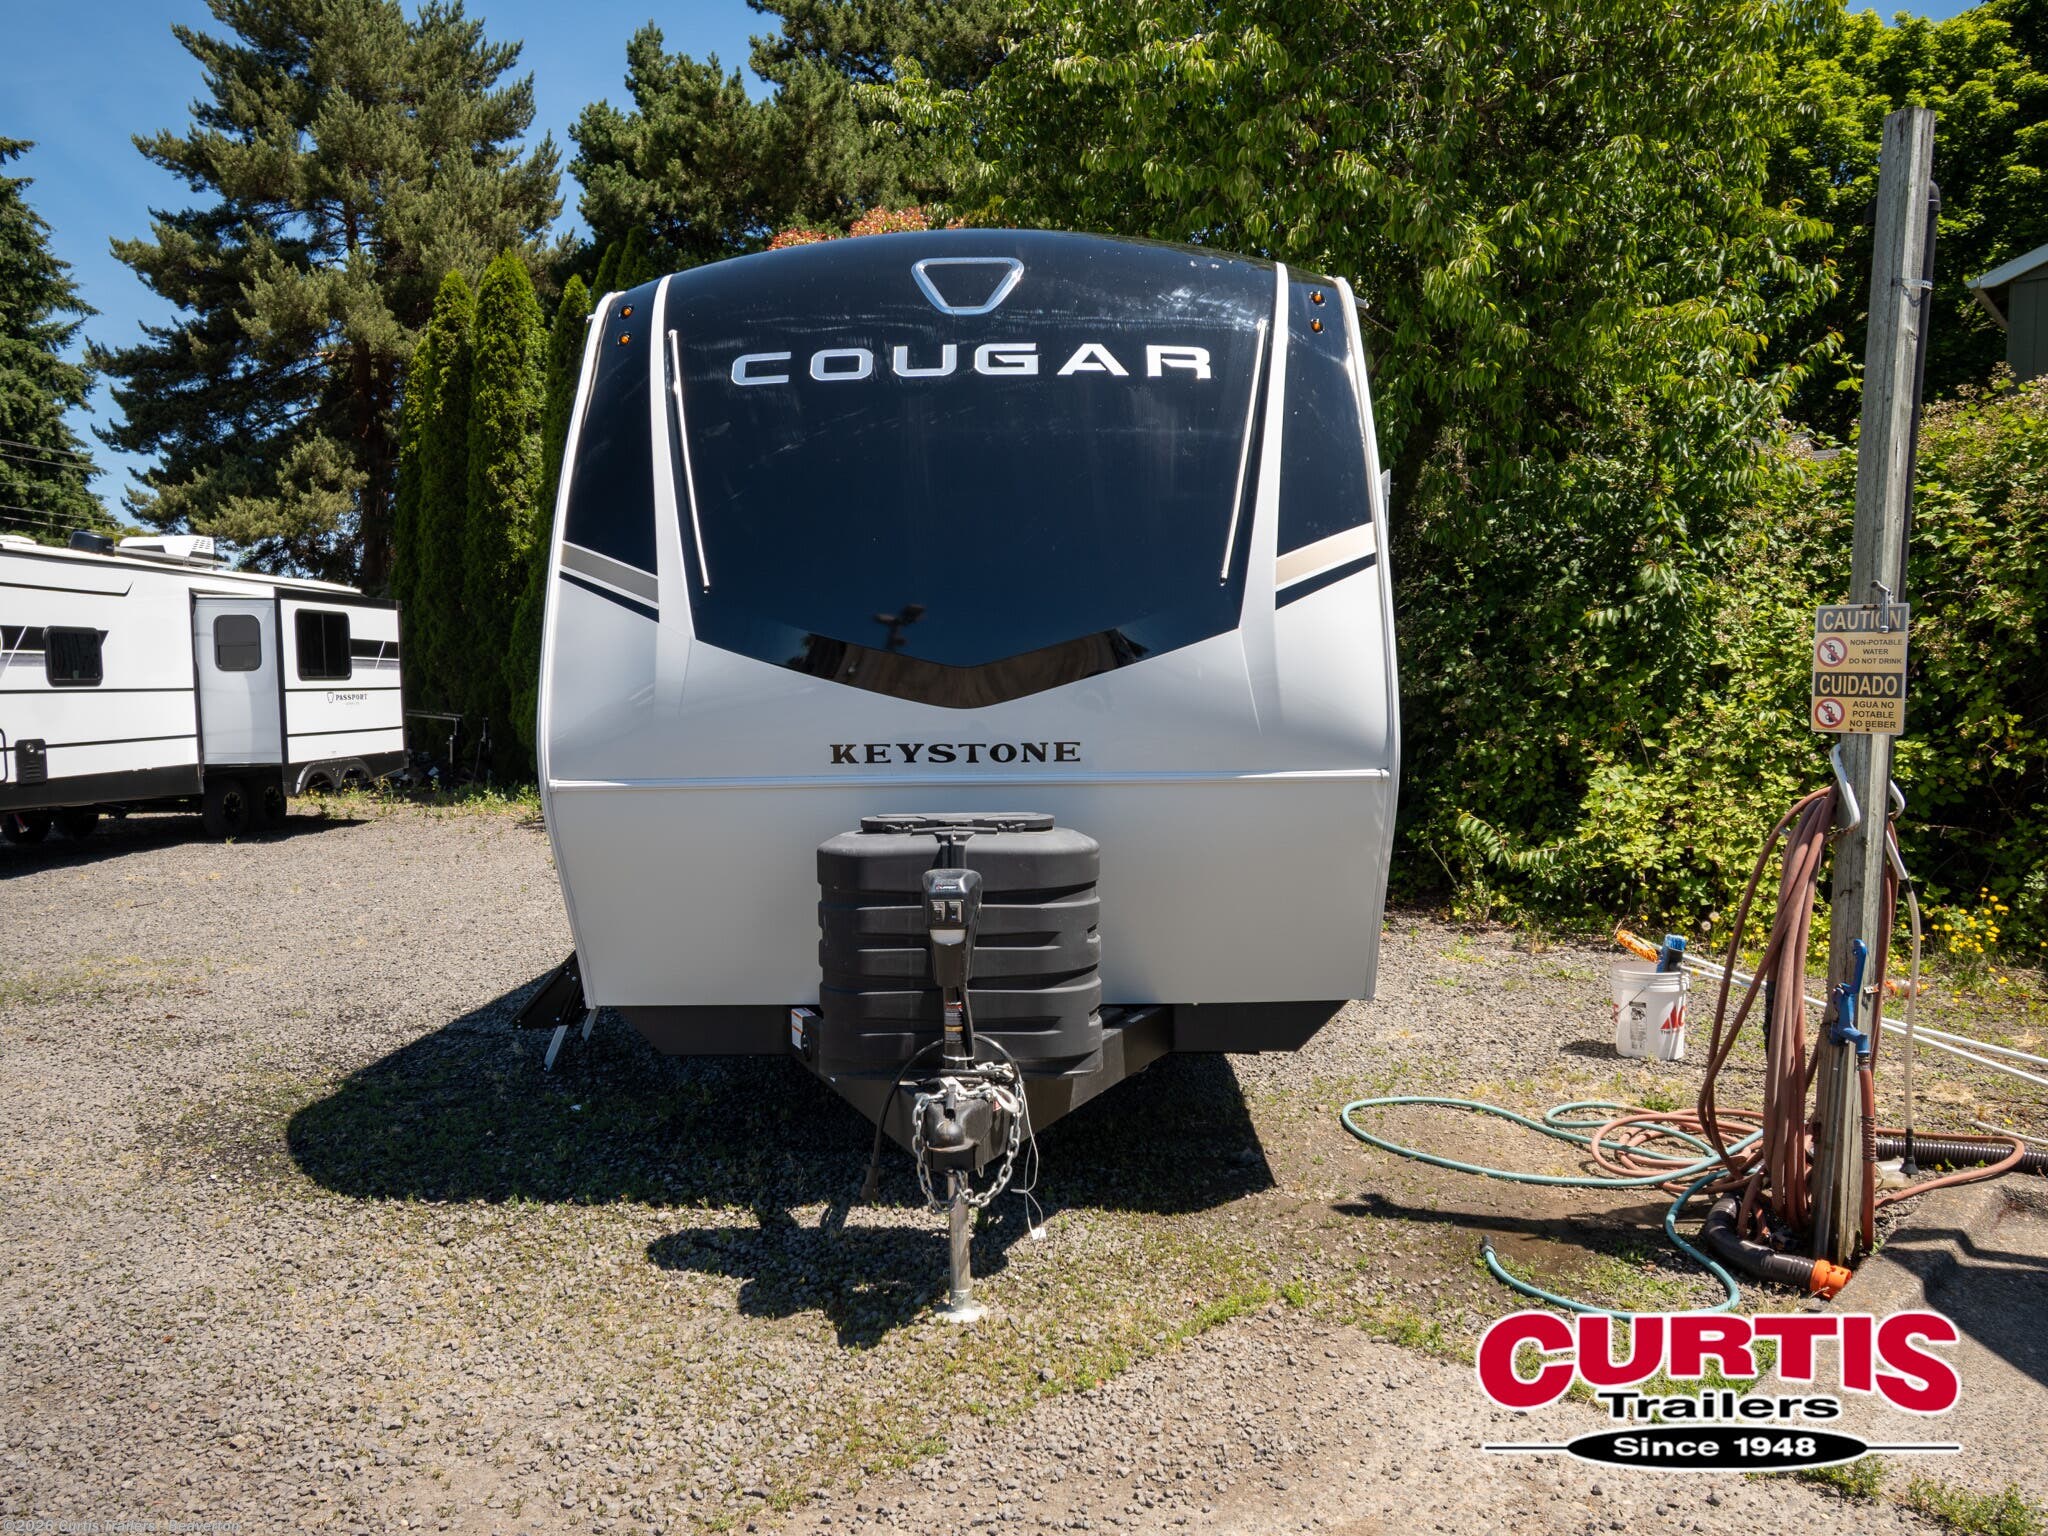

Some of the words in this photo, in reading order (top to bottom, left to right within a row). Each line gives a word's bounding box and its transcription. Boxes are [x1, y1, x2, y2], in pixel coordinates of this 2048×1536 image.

[731, 342, 1212, 385] COUGAR
[1819, 674, 1898, 696] CUIDADO
[1852, 700, 1879, 708] AGUA
[1880, 701, 1895, 709] NO
[1852, 710, 1895, 719] POTABLE
[1849, 720, 1863, 728] NO
[1865, 720, 1897, 729] BEBER
[829, 741, 1081, 764] KEYSTONE
